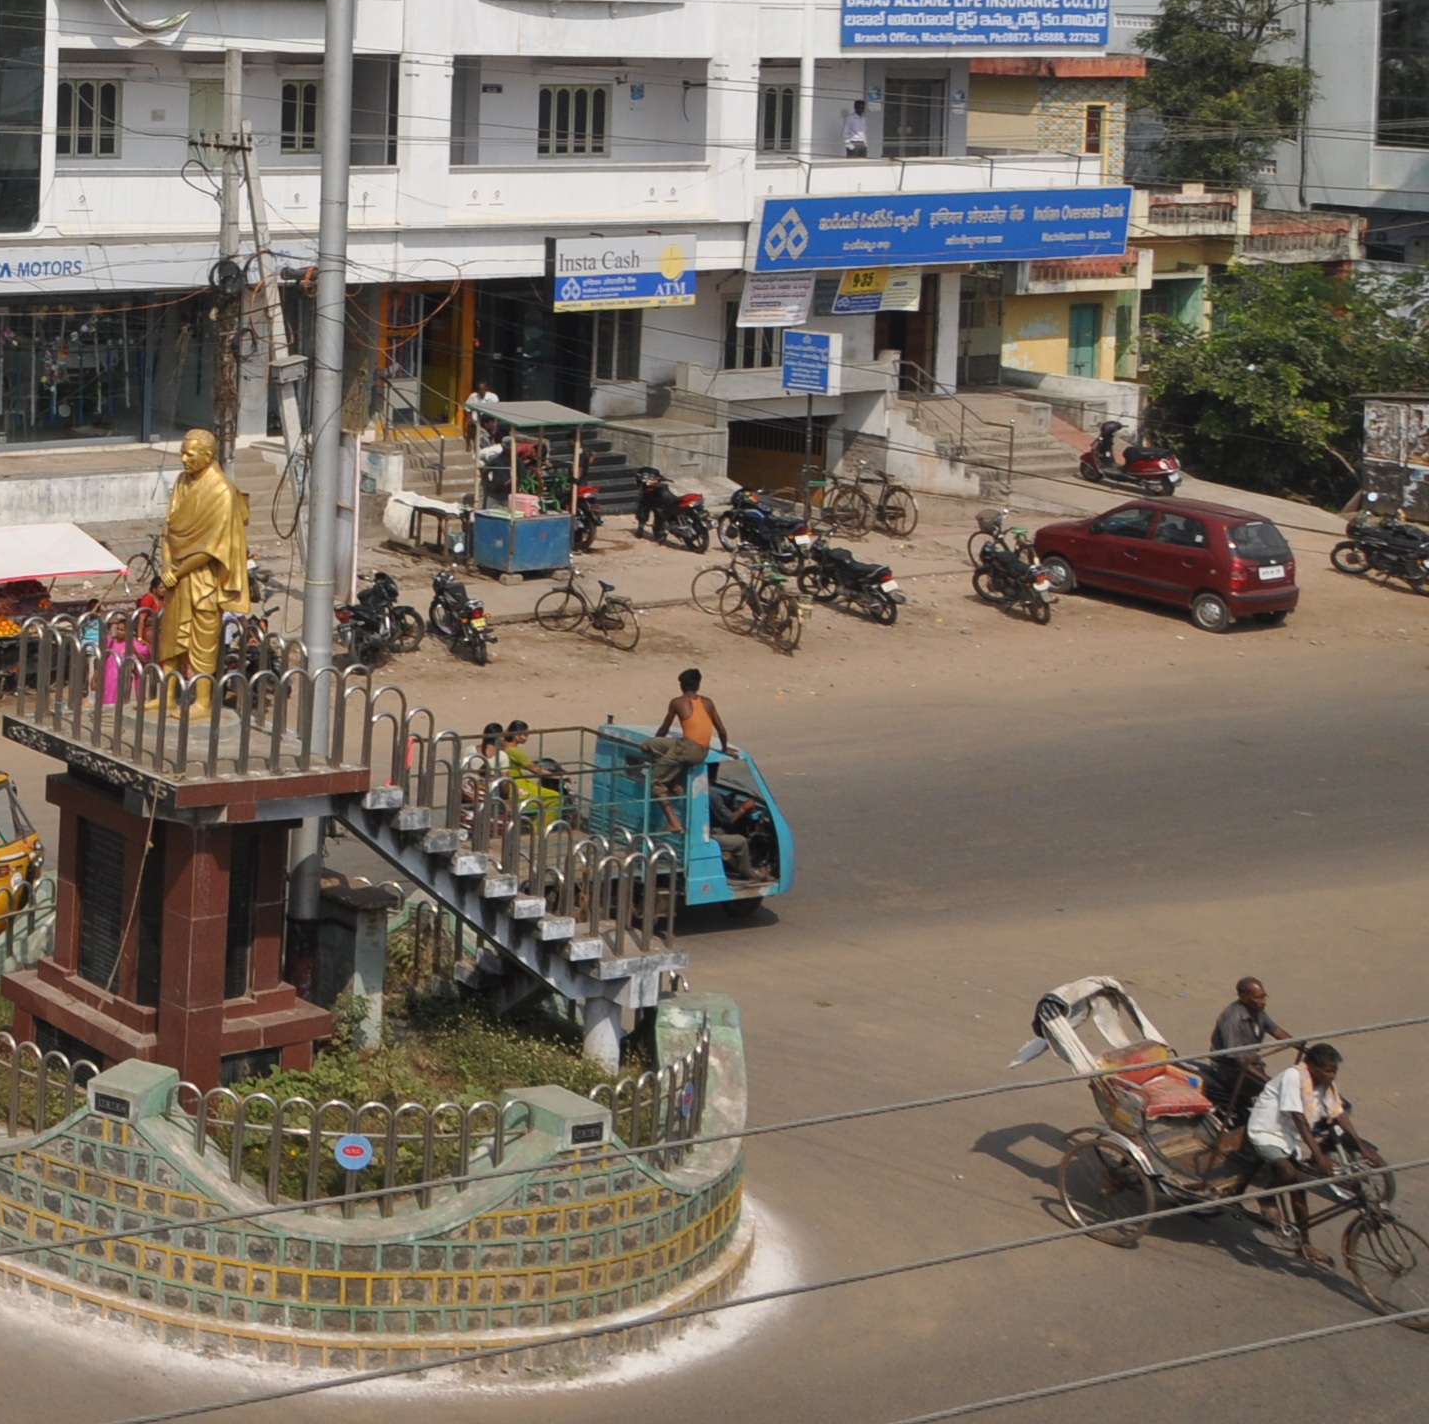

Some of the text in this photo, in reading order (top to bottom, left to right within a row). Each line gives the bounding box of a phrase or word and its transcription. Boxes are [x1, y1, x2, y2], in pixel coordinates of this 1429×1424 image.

[854, 32, 887, 43] Branch
[889, 32, 919, 44] Office,
[921, 32, 988, 44] Machilipatnam,
[1033, 204, 1124, 221] Indian Overseas Bank
[17, 260, 82, 277] MOTORS
[559, 250, 640, 272] Insta Cash
[655, 282, 686, 296] ATM
